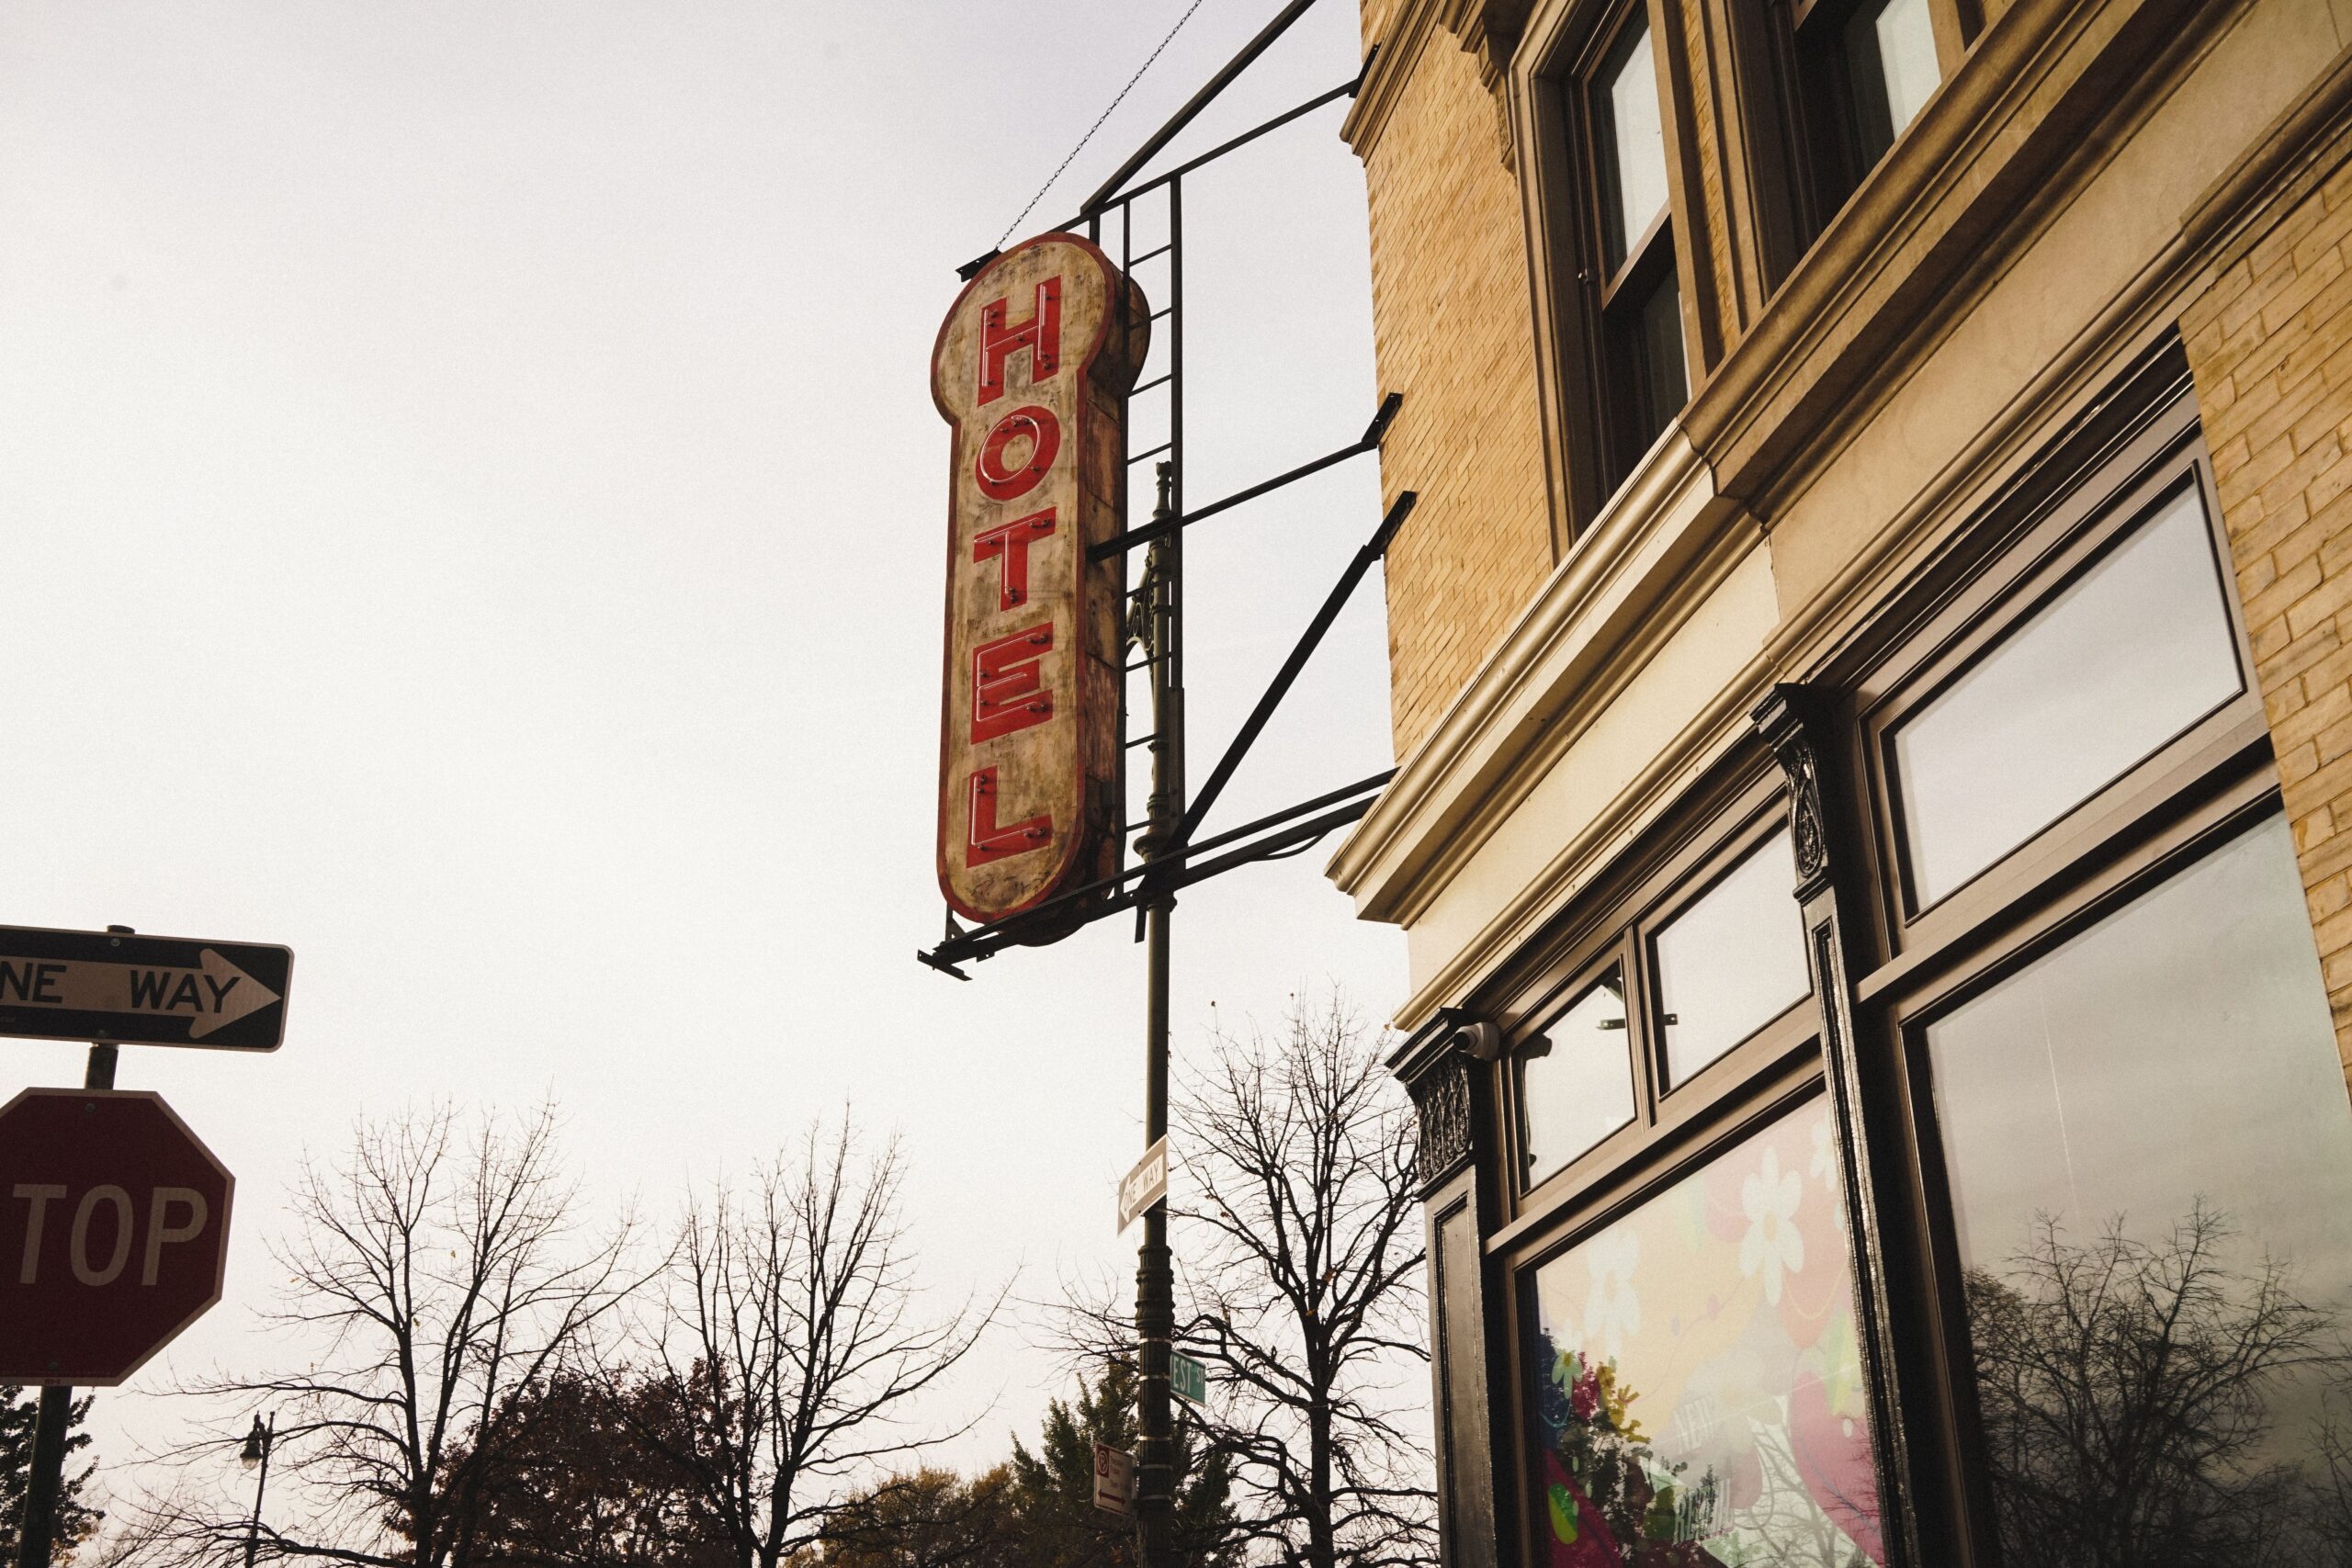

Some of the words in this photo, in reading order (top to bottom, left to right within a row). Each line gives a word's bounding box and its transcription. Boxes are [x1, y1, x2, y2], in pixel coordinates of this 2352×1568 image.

[966, 275, 1062, 869] HOTEL
[130, 969, 242, 1014] WAY
[1124, 1182, 1137, 1212] ONE
[1142, 1160, 1160, 1192] WAY
[1196, 1366, 1204, 1384] ST
